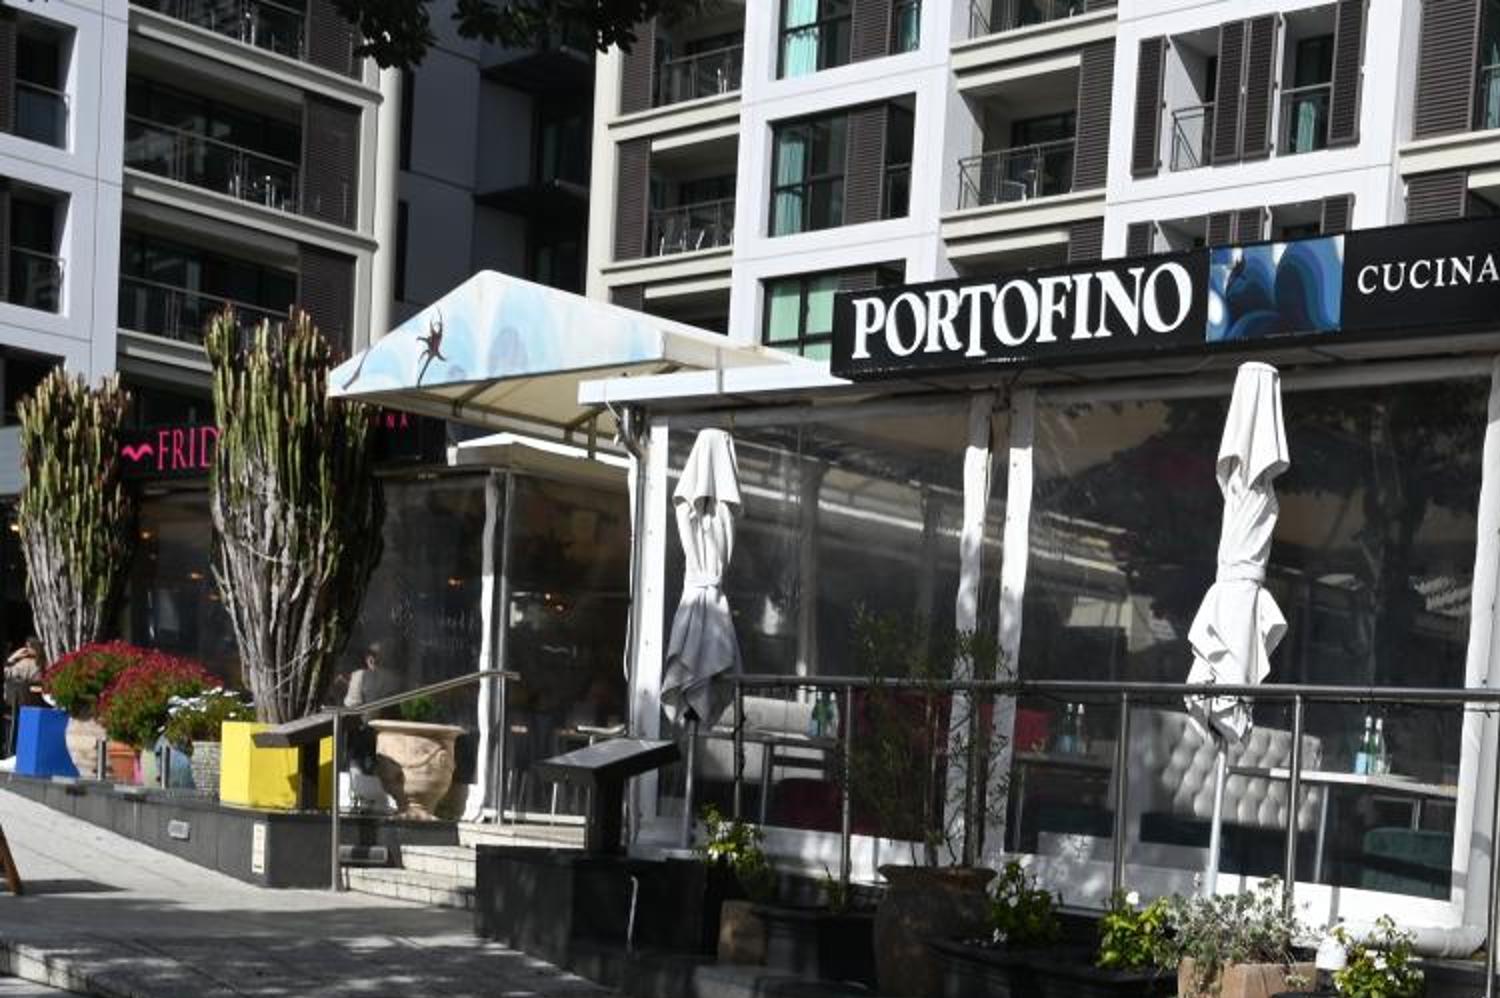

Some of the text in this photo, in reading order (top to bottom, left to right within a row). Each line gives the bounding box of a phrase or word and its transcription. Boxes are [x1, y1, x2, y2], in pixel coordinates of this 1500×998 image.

[1356, 253, 1500, 295] CUCINA
[851, 261, 1194, 360] PORTOFINO
[157, 426, 219, 470] FRID
